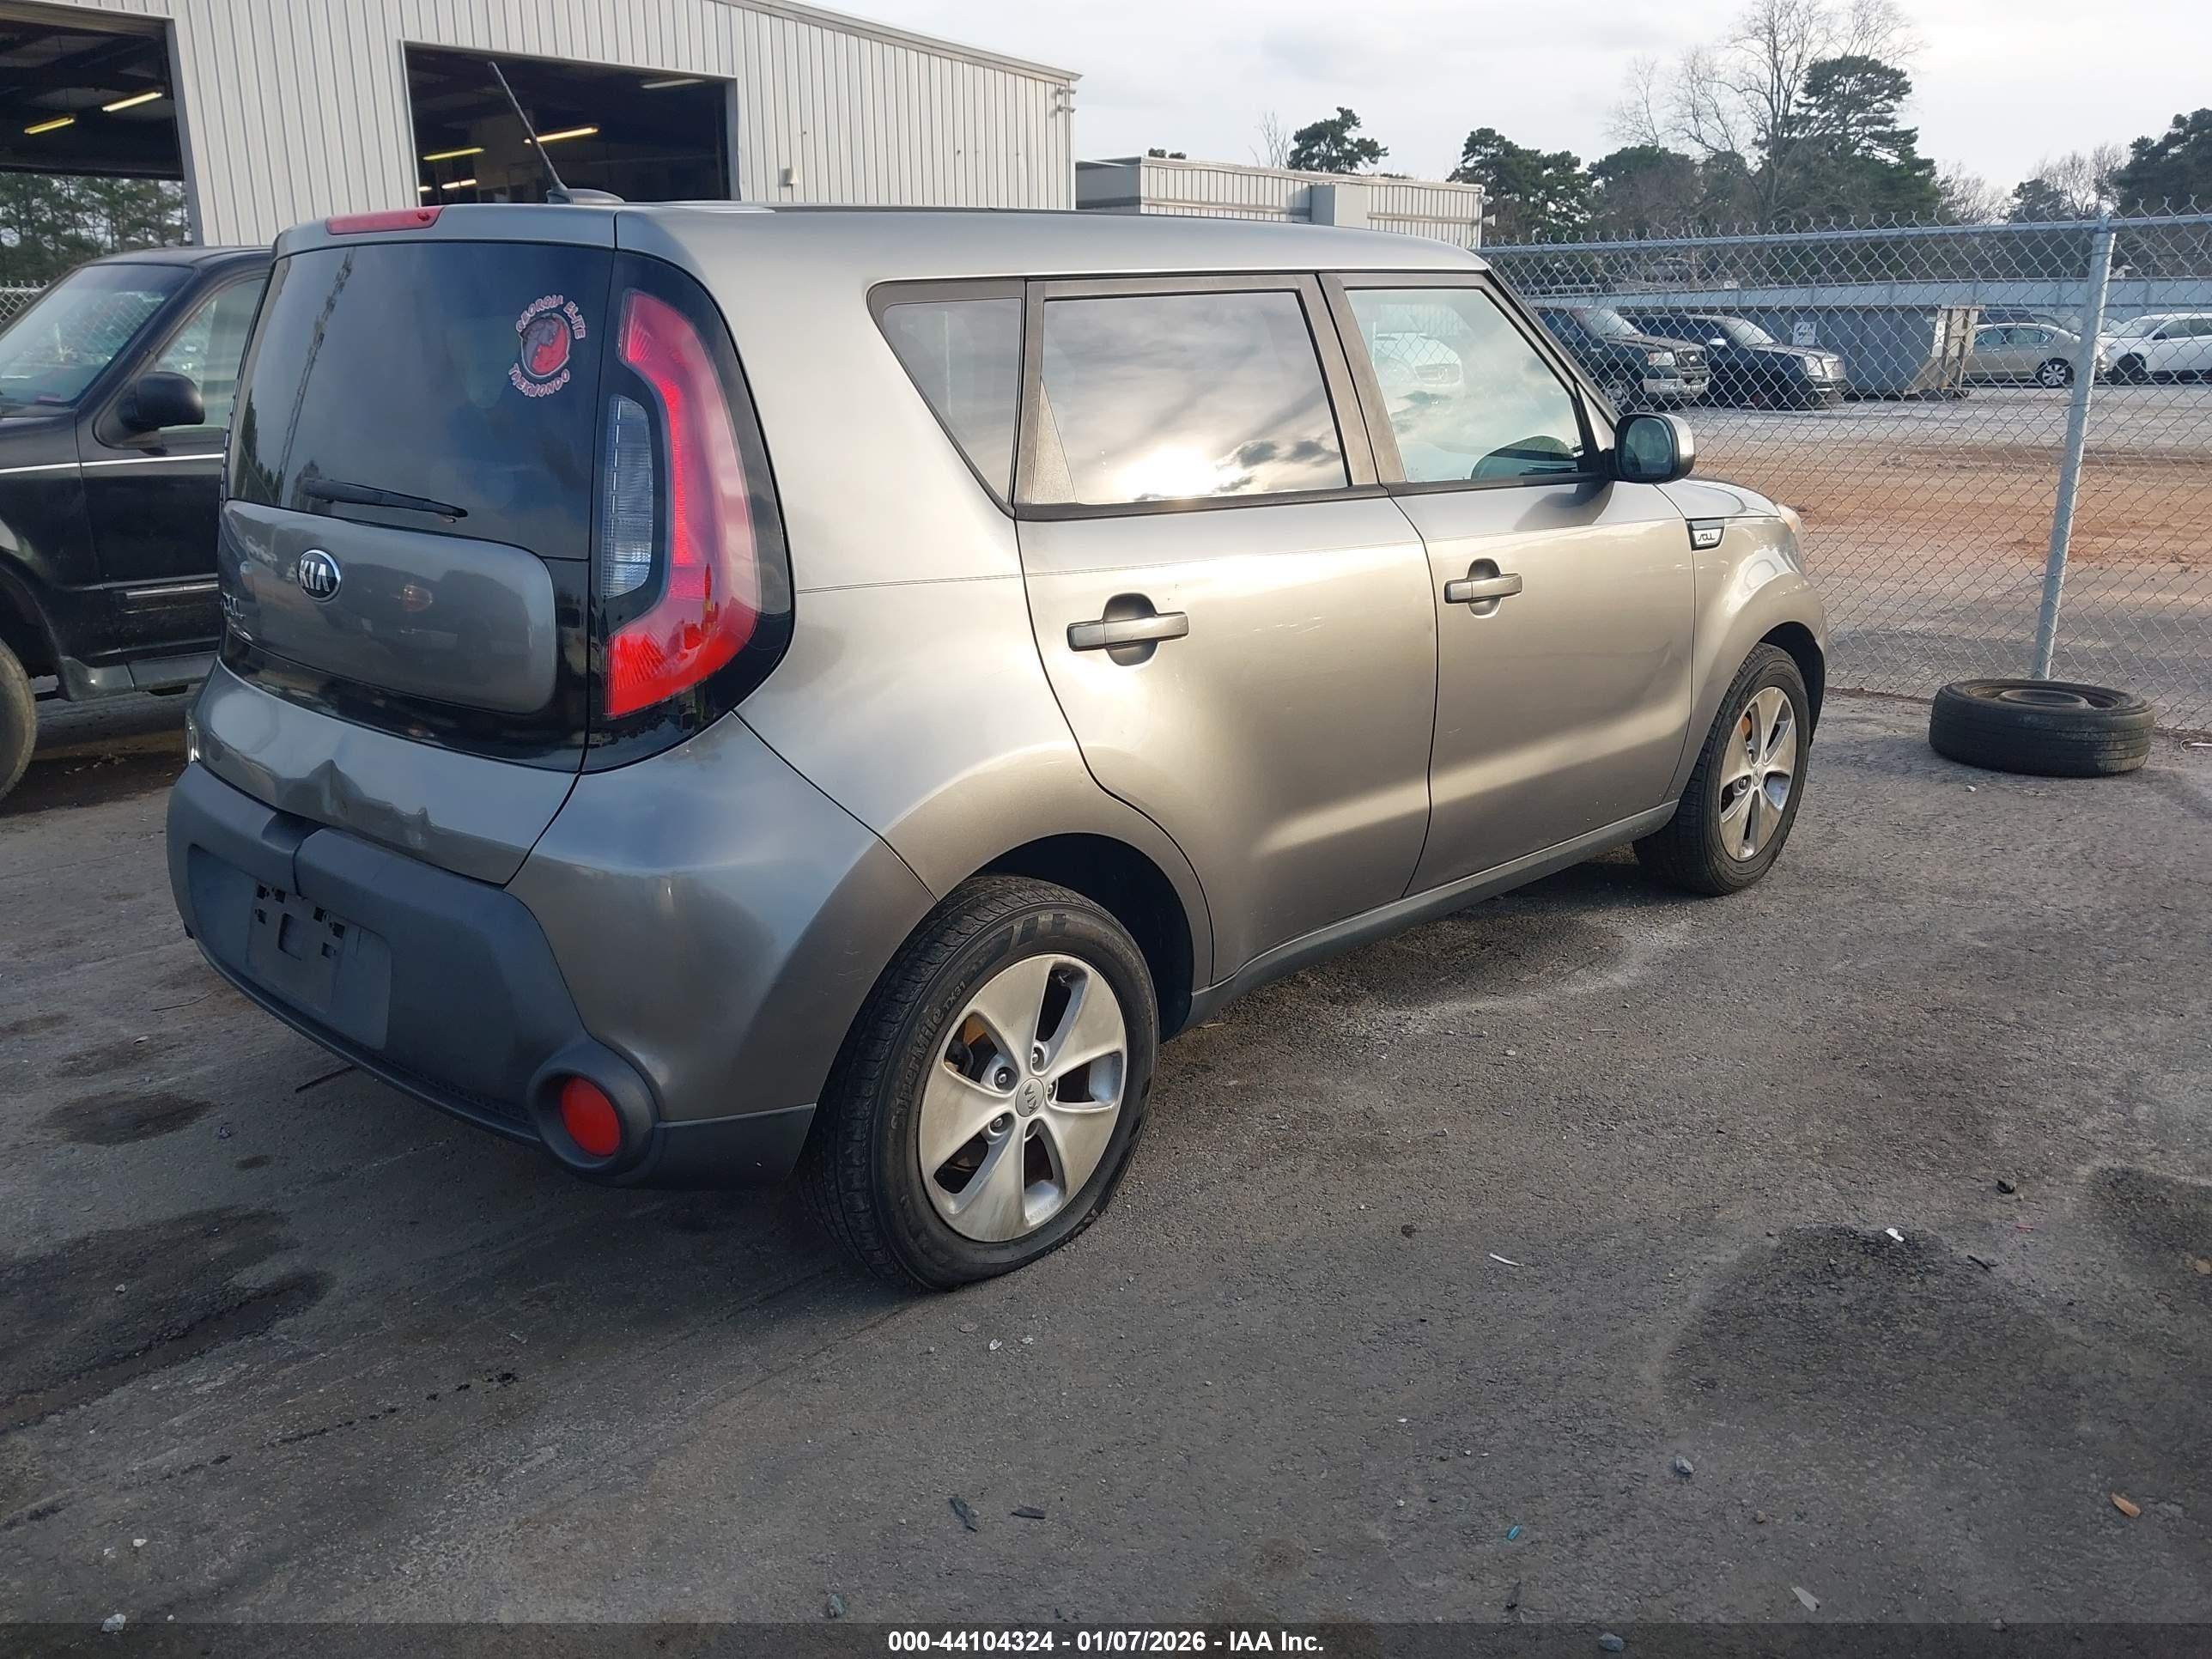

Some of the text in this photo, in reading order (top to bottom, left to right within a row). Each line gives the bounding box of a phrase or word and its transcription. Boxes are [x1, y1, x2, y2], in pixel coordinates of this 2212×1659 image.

[516, 295, 586, 339] GEORGIA ELITE
[508, 362, 570, 397] TAEKWONDO
[299, 559, 331, 592] KIA
[1024, 1082, 1038, 1115] KIA
